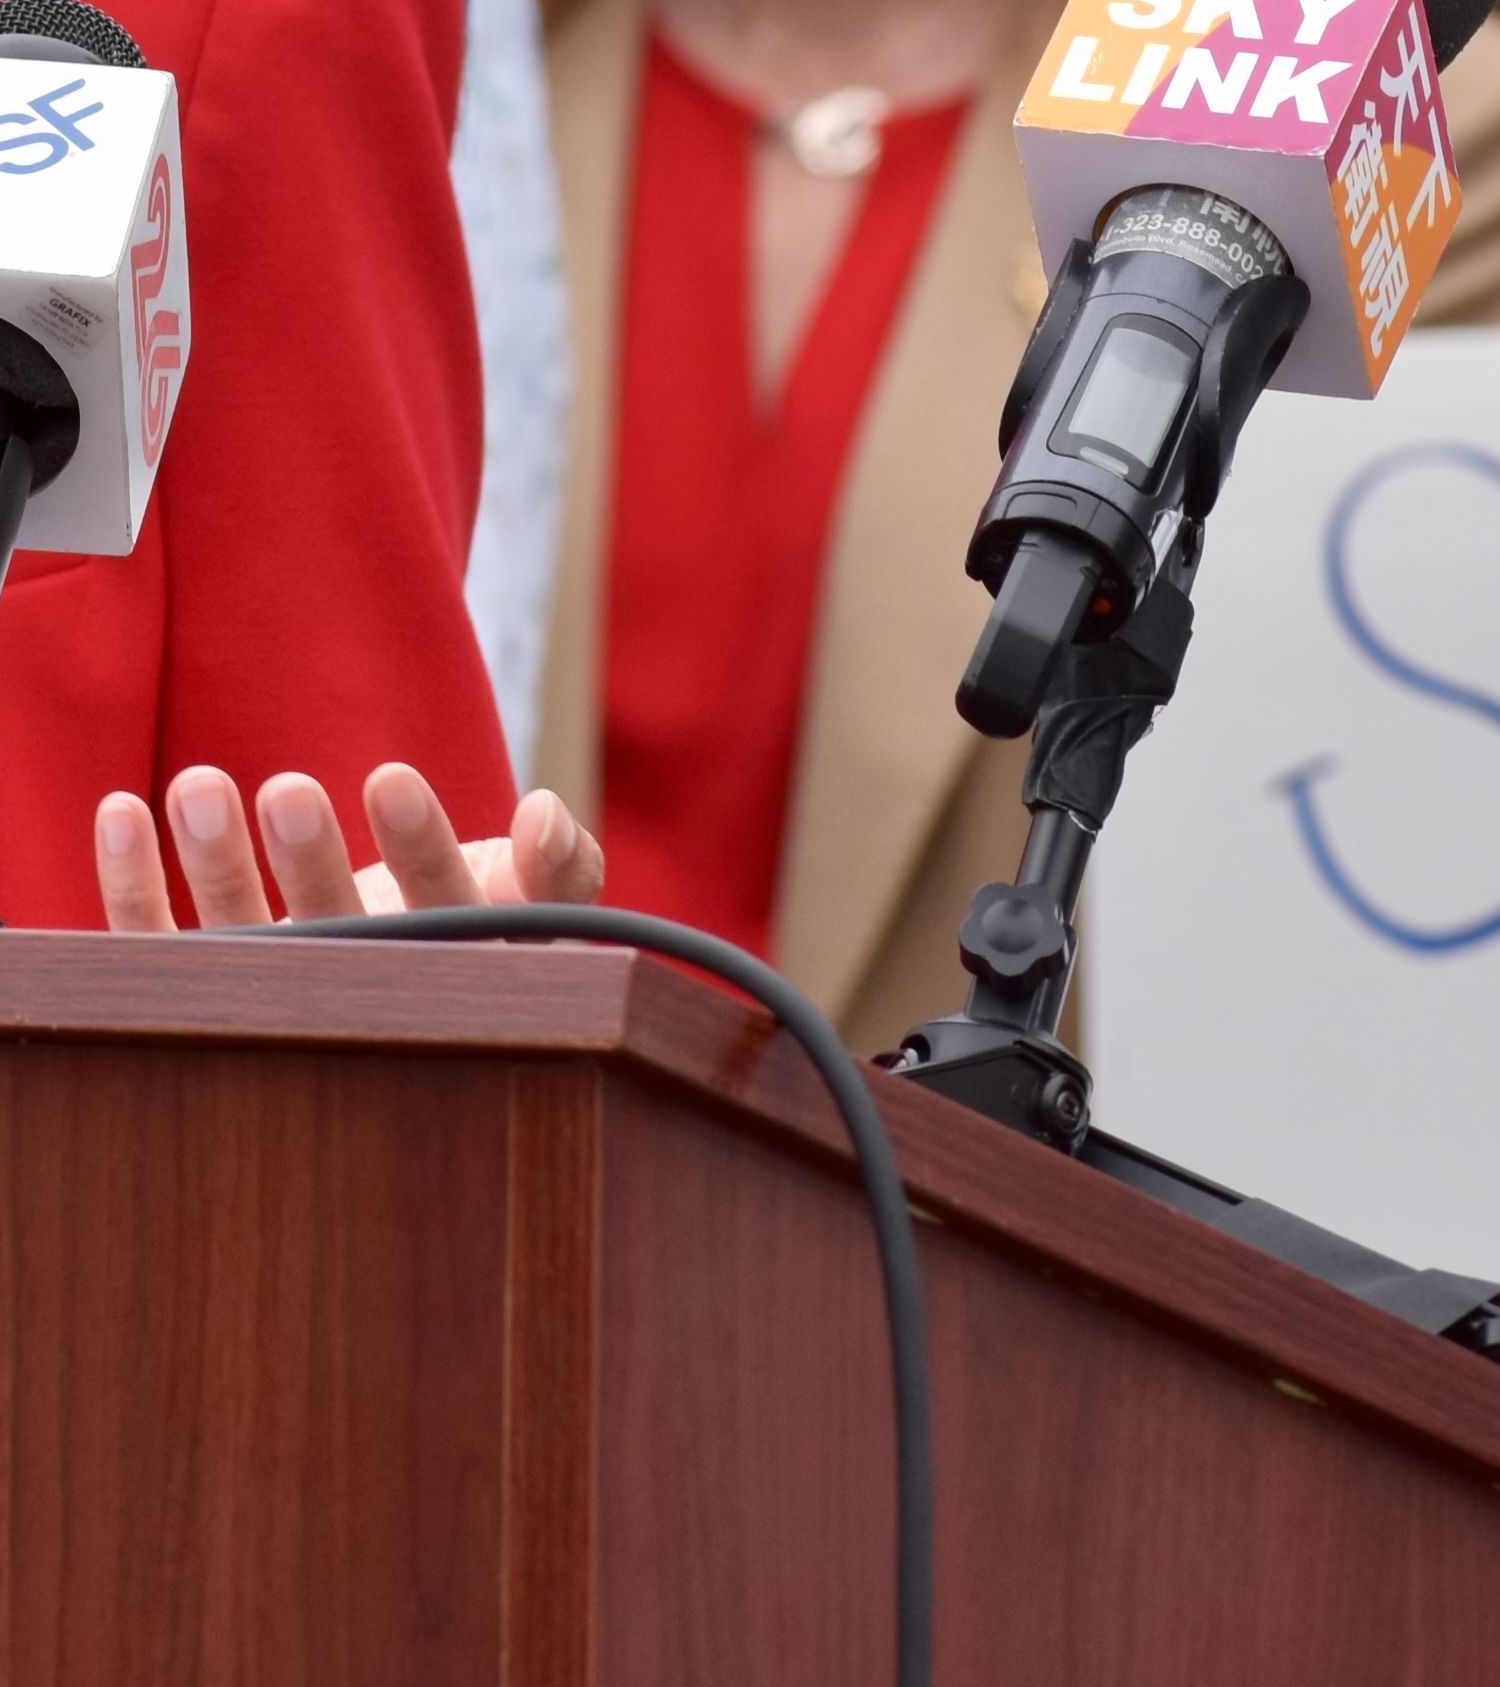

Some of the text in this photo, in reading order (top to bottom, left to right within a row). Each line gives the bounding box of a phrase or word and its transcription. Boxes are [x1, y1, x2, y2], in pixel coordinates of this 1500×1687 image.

[1049, 36, 1353, 124] LINK
[1380, 0, 1452, 233] 天下
[49, 298, 90, 327] GRAFIX
